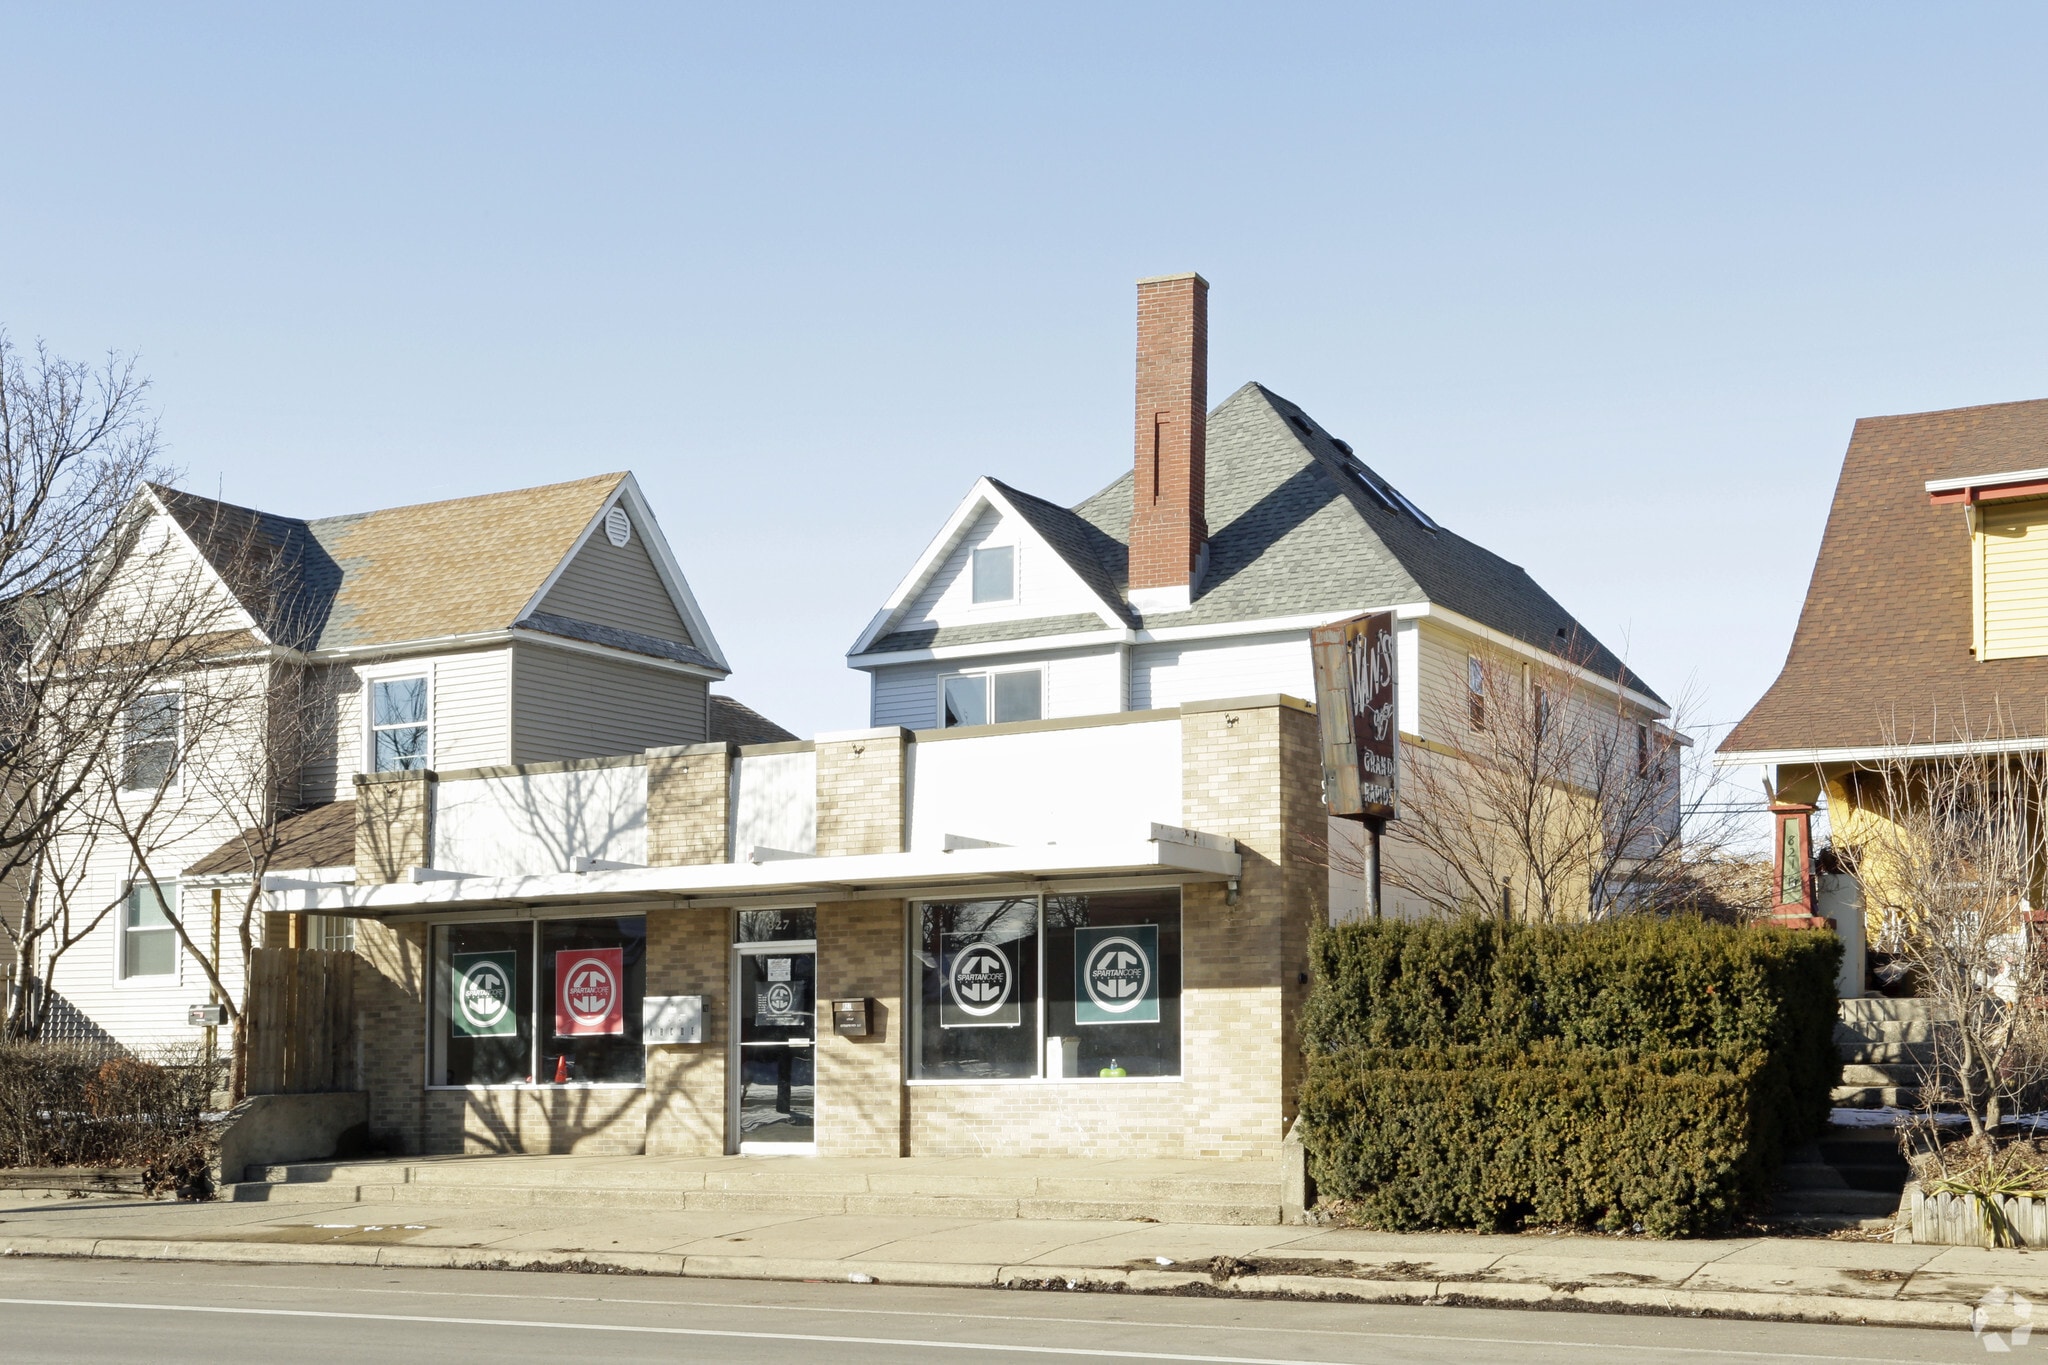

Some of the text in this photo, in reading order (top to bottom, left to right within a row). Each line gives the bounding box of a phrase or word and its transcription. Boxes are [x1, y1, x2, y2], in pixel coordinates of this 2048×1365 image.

[1363, 751, 1394, 777] GRAND
[1364, 782, 1394, 807] RAPIDS
[767, 919, 790, 930] 827
[957, 972, 1004, 981] SPARTANCORE
[1092, 968, 1142, 977] SPARTANCORE
